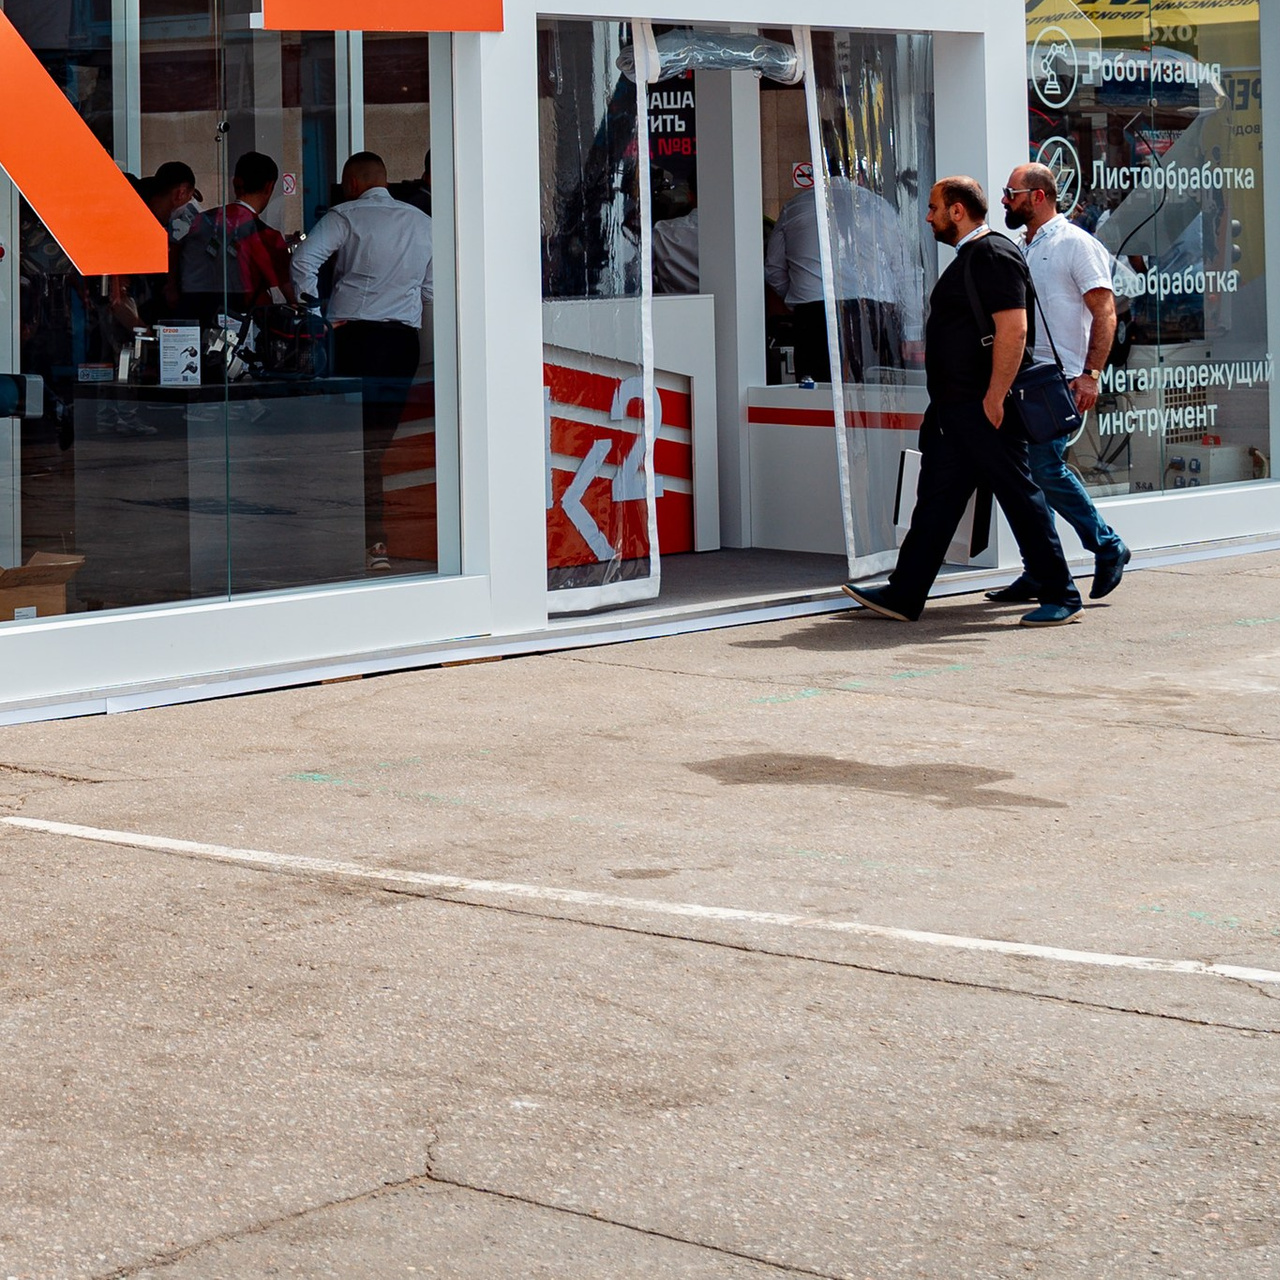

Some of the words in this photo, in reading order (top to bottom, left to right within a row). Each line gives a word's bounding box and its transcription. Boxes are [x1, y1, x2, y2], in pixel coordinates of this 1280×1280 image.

[1143, 18, 1199, 45] Вхо
[1087, 51, 1221, 88] Роботизация
[647, 115, 686, 132] ИТЬ
[1091, 160, 1255, 195] Листообработка
[1112, 265, 1238, 301] ехобработка
[1098, 353, 1276, 394] Металлорежущий
[1098, 403, 1218, 436] инструмент
